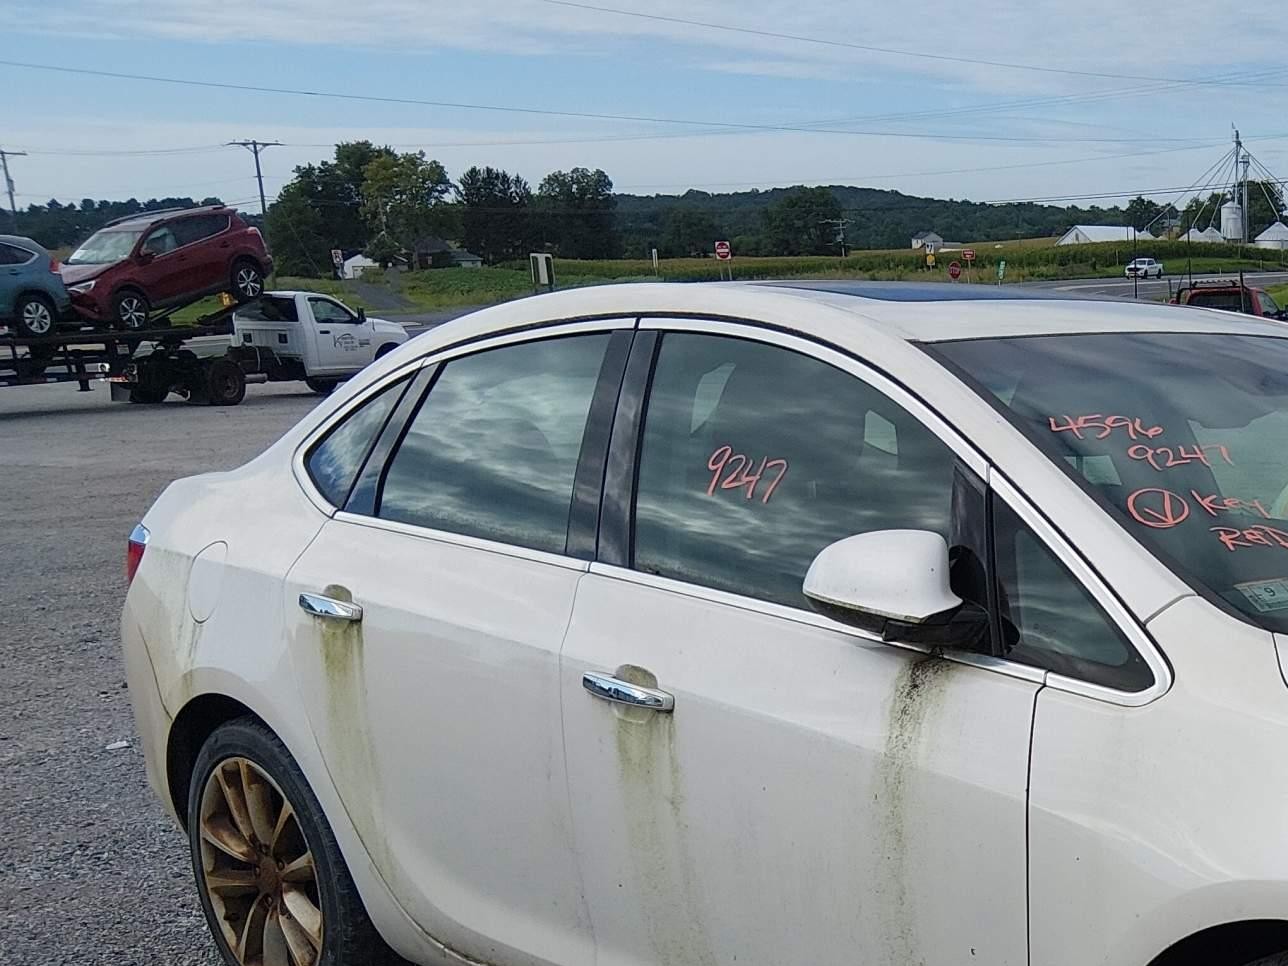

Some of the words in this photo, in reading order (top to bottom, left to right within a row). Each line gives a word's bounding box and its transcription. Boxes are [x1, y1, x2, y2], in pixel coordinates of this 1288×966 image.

[1048, 414, 1164, 440] 4596
[1127, 444, 1234, 471] 9247
[705, 445, 788, 504] 9247
